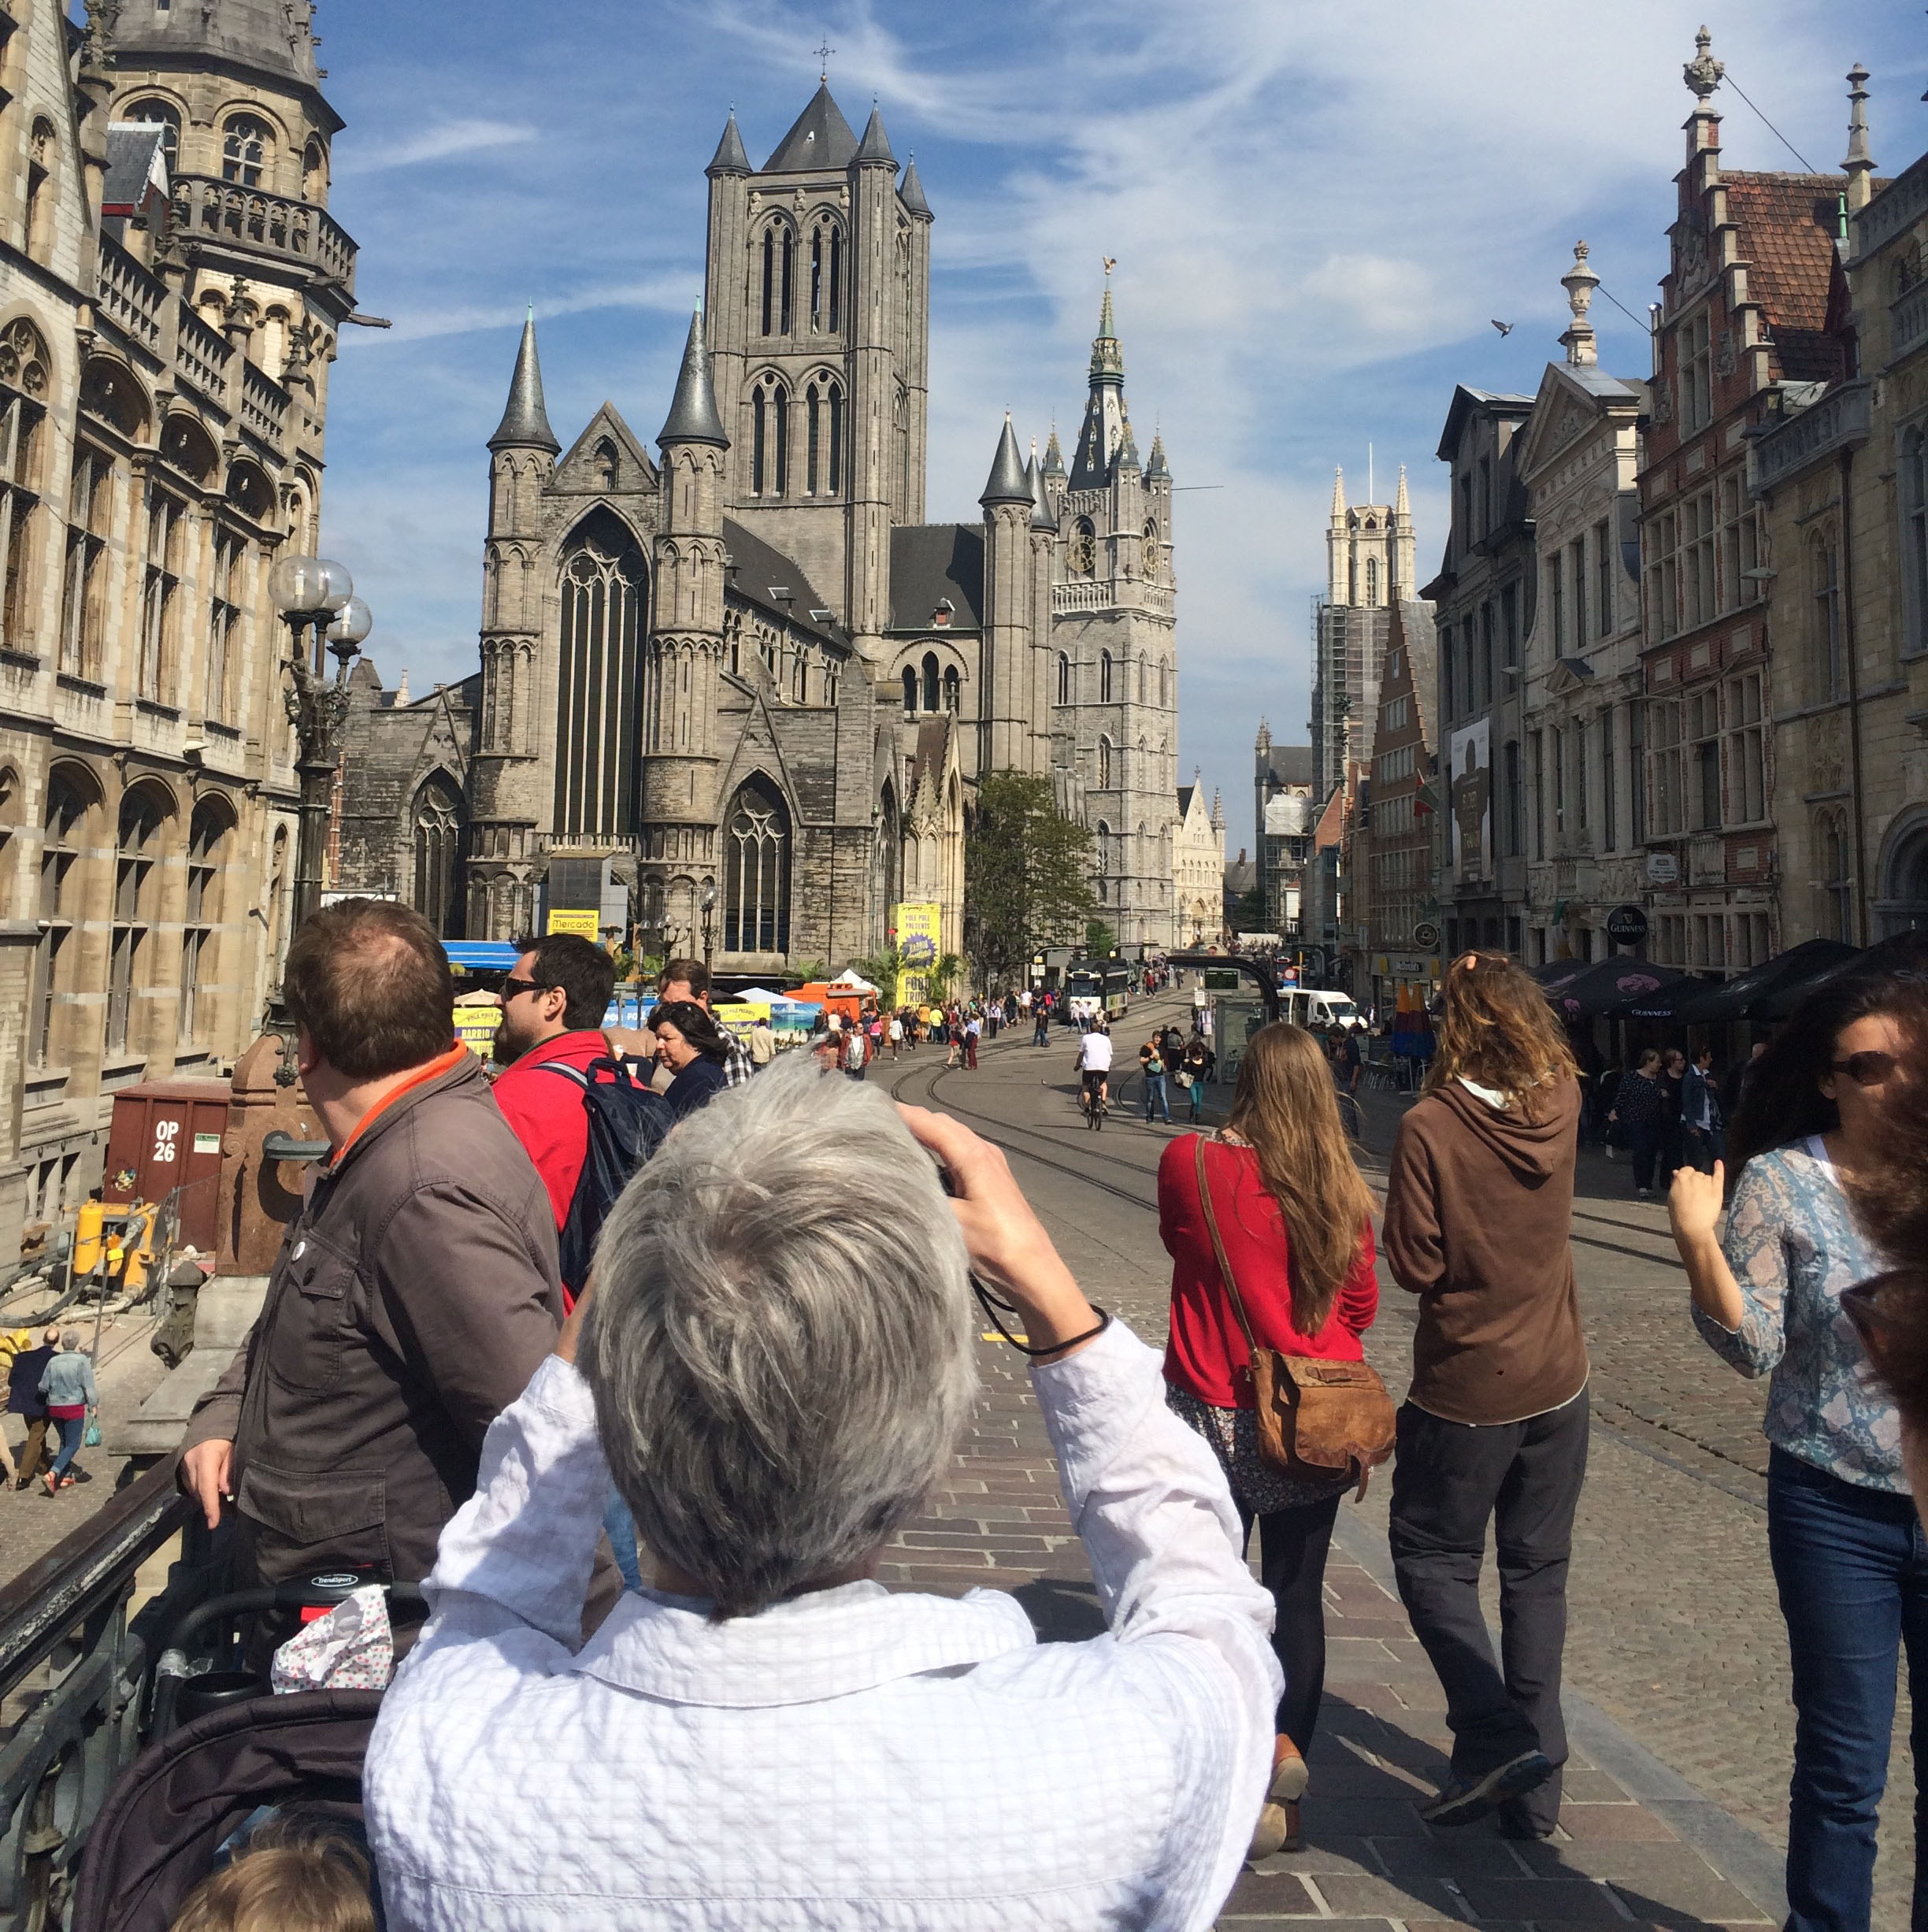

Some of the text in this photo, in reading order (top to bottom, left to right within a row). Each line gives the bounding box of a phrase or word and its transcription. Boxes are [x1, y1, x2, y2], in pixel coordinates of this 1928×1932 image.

[553, 919, 595, 929] Mercado
[1611, 923, 1646, 933] GUINNESS
[905, 977, 931, 991] FOOD
[462, 1029, 491, 1040] BARRIO
[156, 1120, 179, 1141] OP
[153, 1141, 176, 1163] 26
